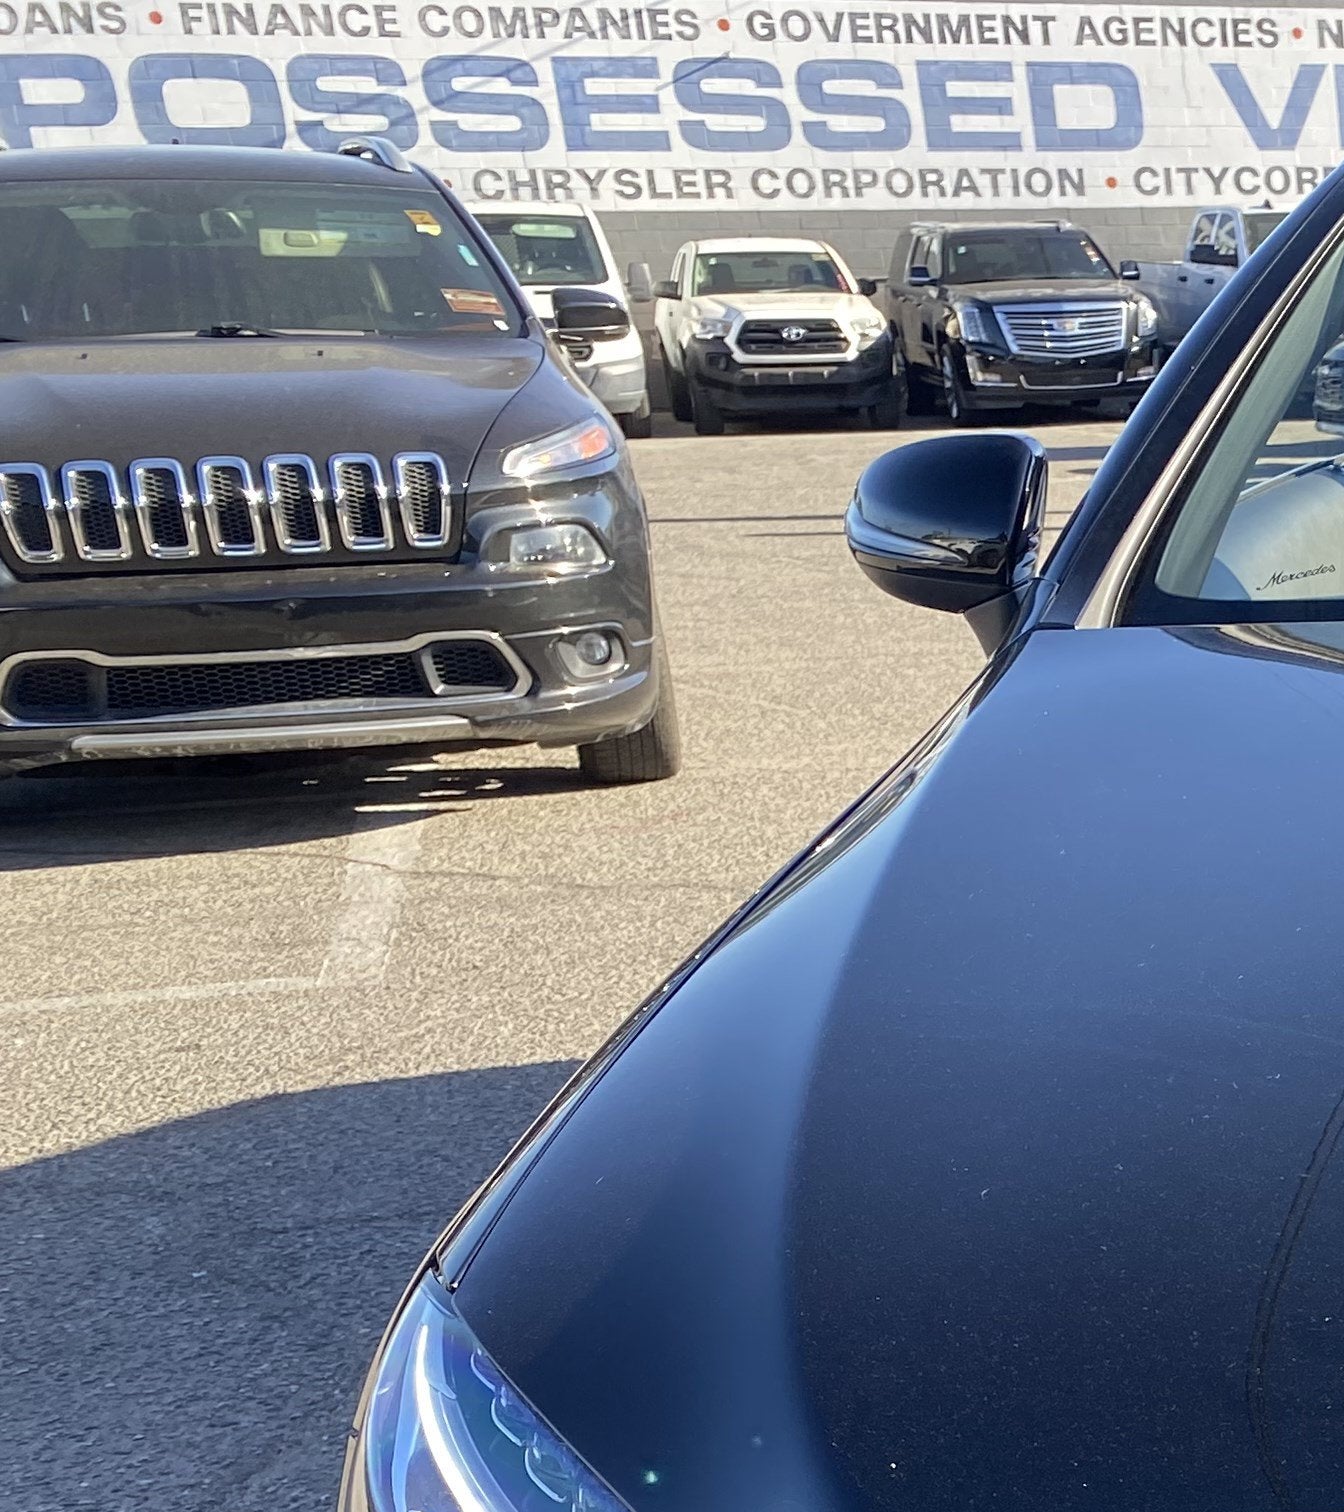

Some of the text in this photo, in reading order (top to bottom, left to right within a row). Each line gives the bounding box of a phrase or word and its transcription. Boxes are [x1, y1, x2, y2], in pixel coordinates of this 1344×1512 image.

[178, 2, 399, 38] FINANCE
[418, 3, 700, 42] COMPANIES
[745, 10, 1056, 47] GOVERNMENT
[1076, 15, 1279, 49] AGENCIES
[473, 167, 734, 201] CHRYSLER
[749, 166, 1086, 200] CORPORATION
[1133, 166, 1336, 197] CITYCOR
[1255, 563, 1336, 591] Mercedes
